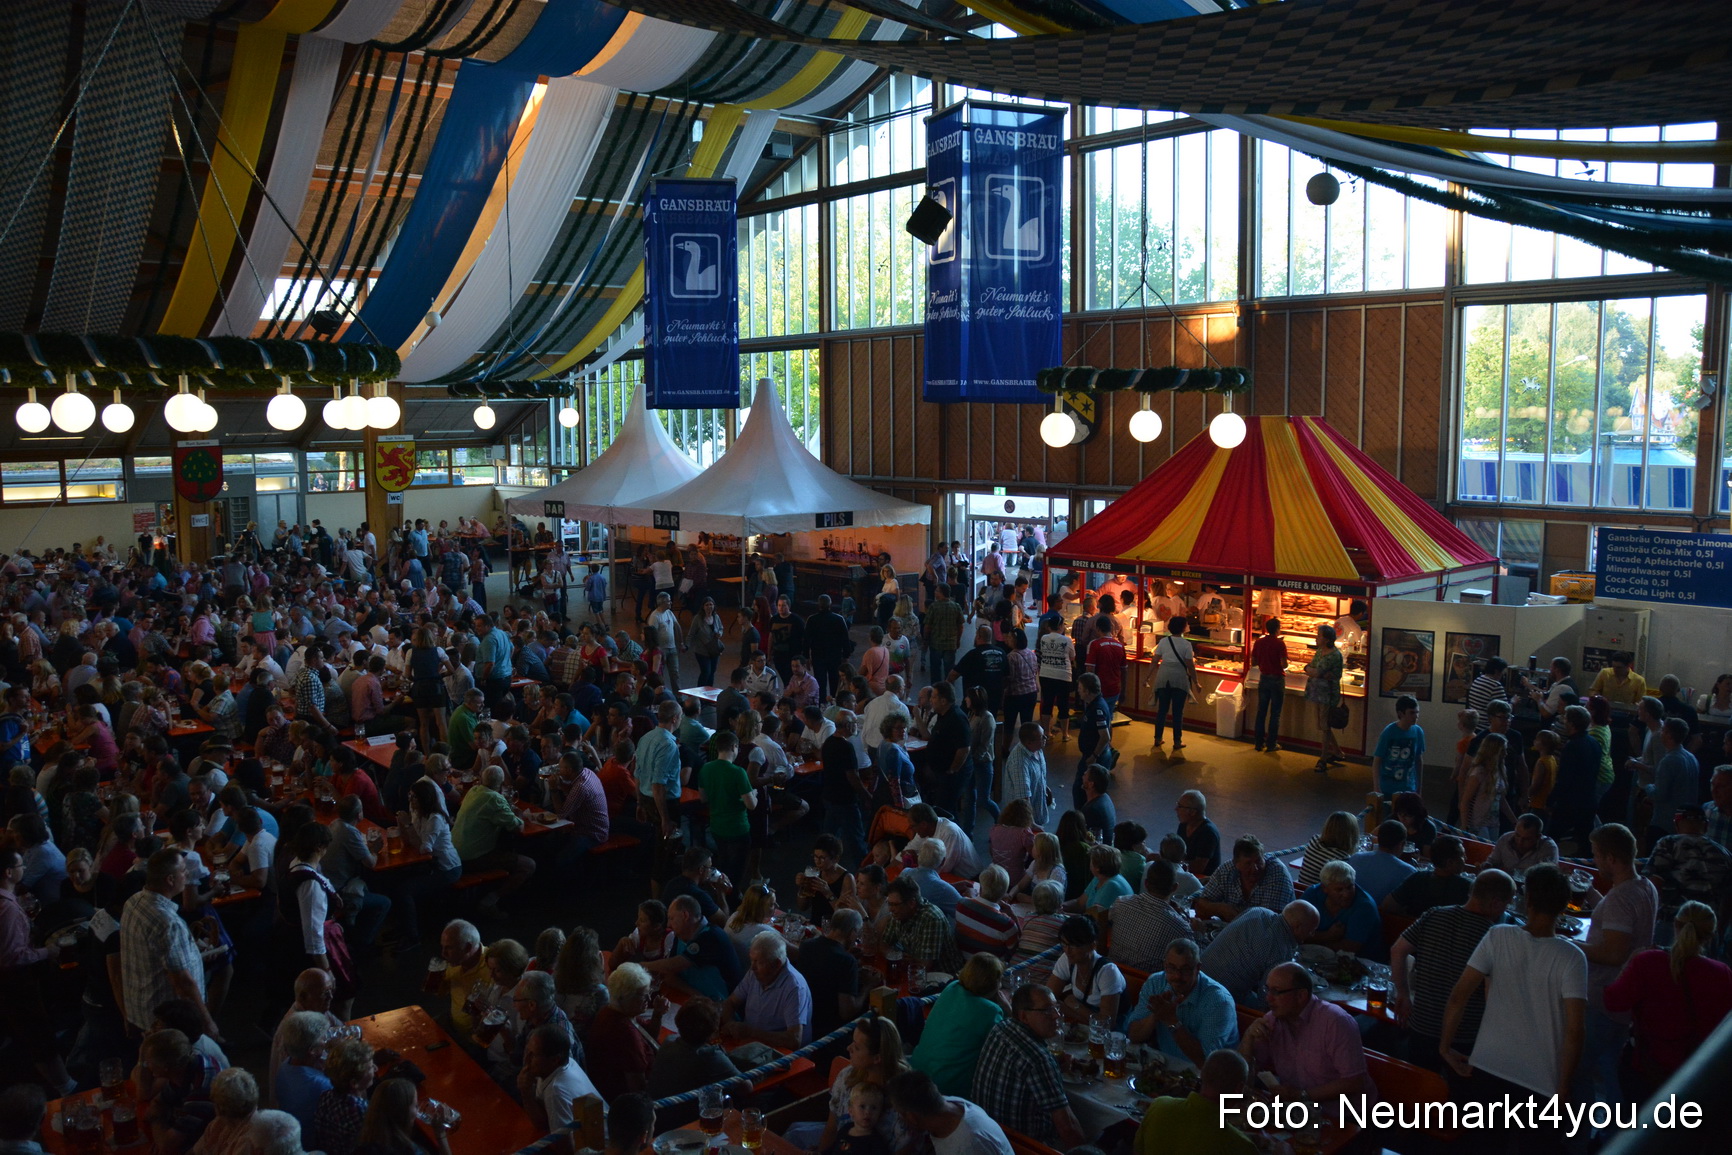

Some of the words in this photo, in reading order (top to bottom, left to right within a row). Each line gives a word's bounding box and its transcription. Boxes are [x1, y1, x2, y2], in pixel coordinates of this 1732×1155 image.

[973, 127, 1058, 150] GANSBRÄU
[660, 198, 731, 212] GANSBRÄU
[980, 286, 1049, 304] Neumarkt's
[975, 305, 1005, 320] guter
[1004, 304, 1054, 321] Schluck
[666, 318, 726, 333] Neumarkt's
[663, 333, 688, 345] guter
[687, 332, 730, 345] Schluck
[545, 503, 564, 515] BAR
[654, 513, 679, 528] BAR
[823, 512, 846, 527] PILS
[1607, 533, 1651, 544] Gansbräu
[1606, 544, 1650, 554] Gansbräu
[1651, 546, 1692, 557] Cola-Mix
[1695, 549, 1714, 558] 0,5l
[1072, 559, 1089, 568] BREZE
[1096, 560, 1112, 570] KÄSE
[1606, 554, 1642, 564] Frucade
[1644, 557, 1702, 568] Apfelschorle
[1705, 561, 1724, 570] 0,5l
[1605, 564, 1671, 577] Mineralwasser
[1673, 569, 1691, 579] 0,5l
[1277, 579, 1302, 589] KAFFEE
[1303, 580, 1309, 589] &
[1310, 583, 1342, 593] KUCHEN
[1605, 575, 1649, 586] Coca-Cola
[1651, 579, 1669, 587] 0,5l
[1604, 585, 1648, 596] Coca-Cola
[1651, 590, 1675, 599] Light
[1678, 591, 1696, 600] 0,5l
